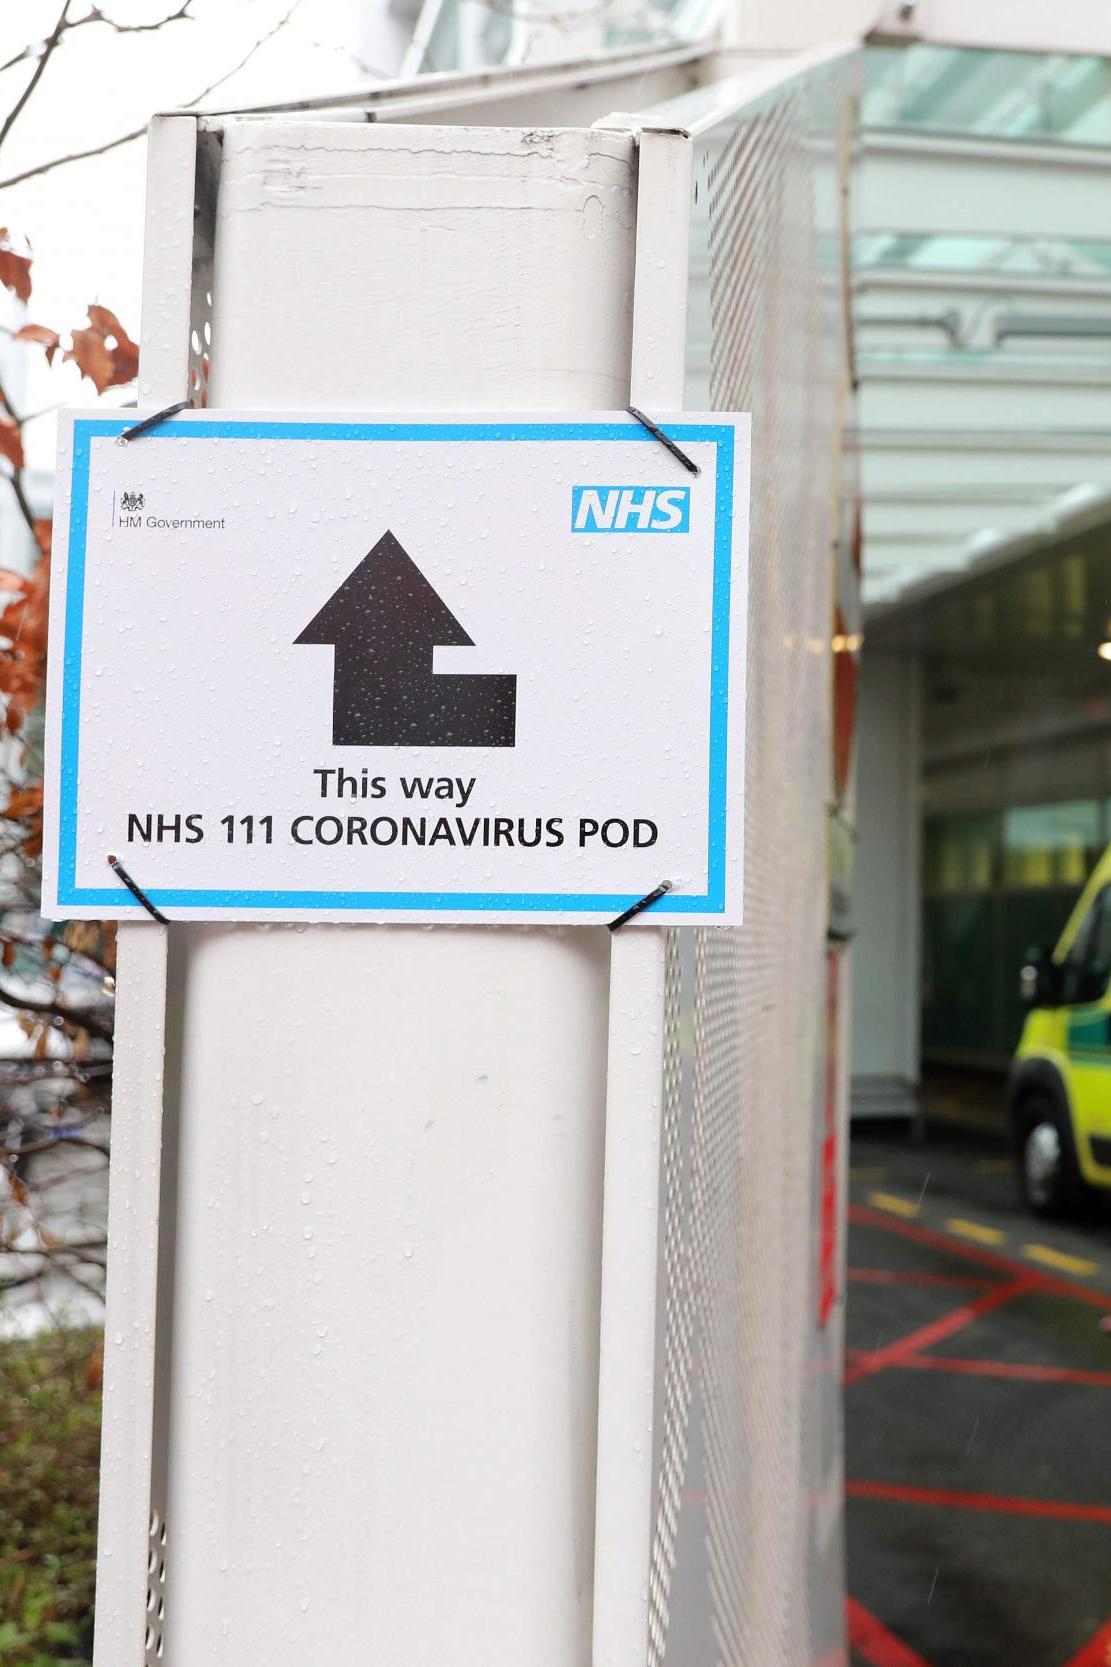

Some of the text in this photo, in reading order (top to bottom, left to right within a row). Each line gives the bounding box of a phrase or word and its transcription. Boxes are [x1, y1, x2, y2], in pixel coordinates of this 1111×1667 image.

[119, 516, 225, 529] HM Government
[574, 489, 687, 530] NHS
[313, 768, 477, 807] This way
[127, 814, 658, 848] NHS 111 CORONAVIRUS POD
